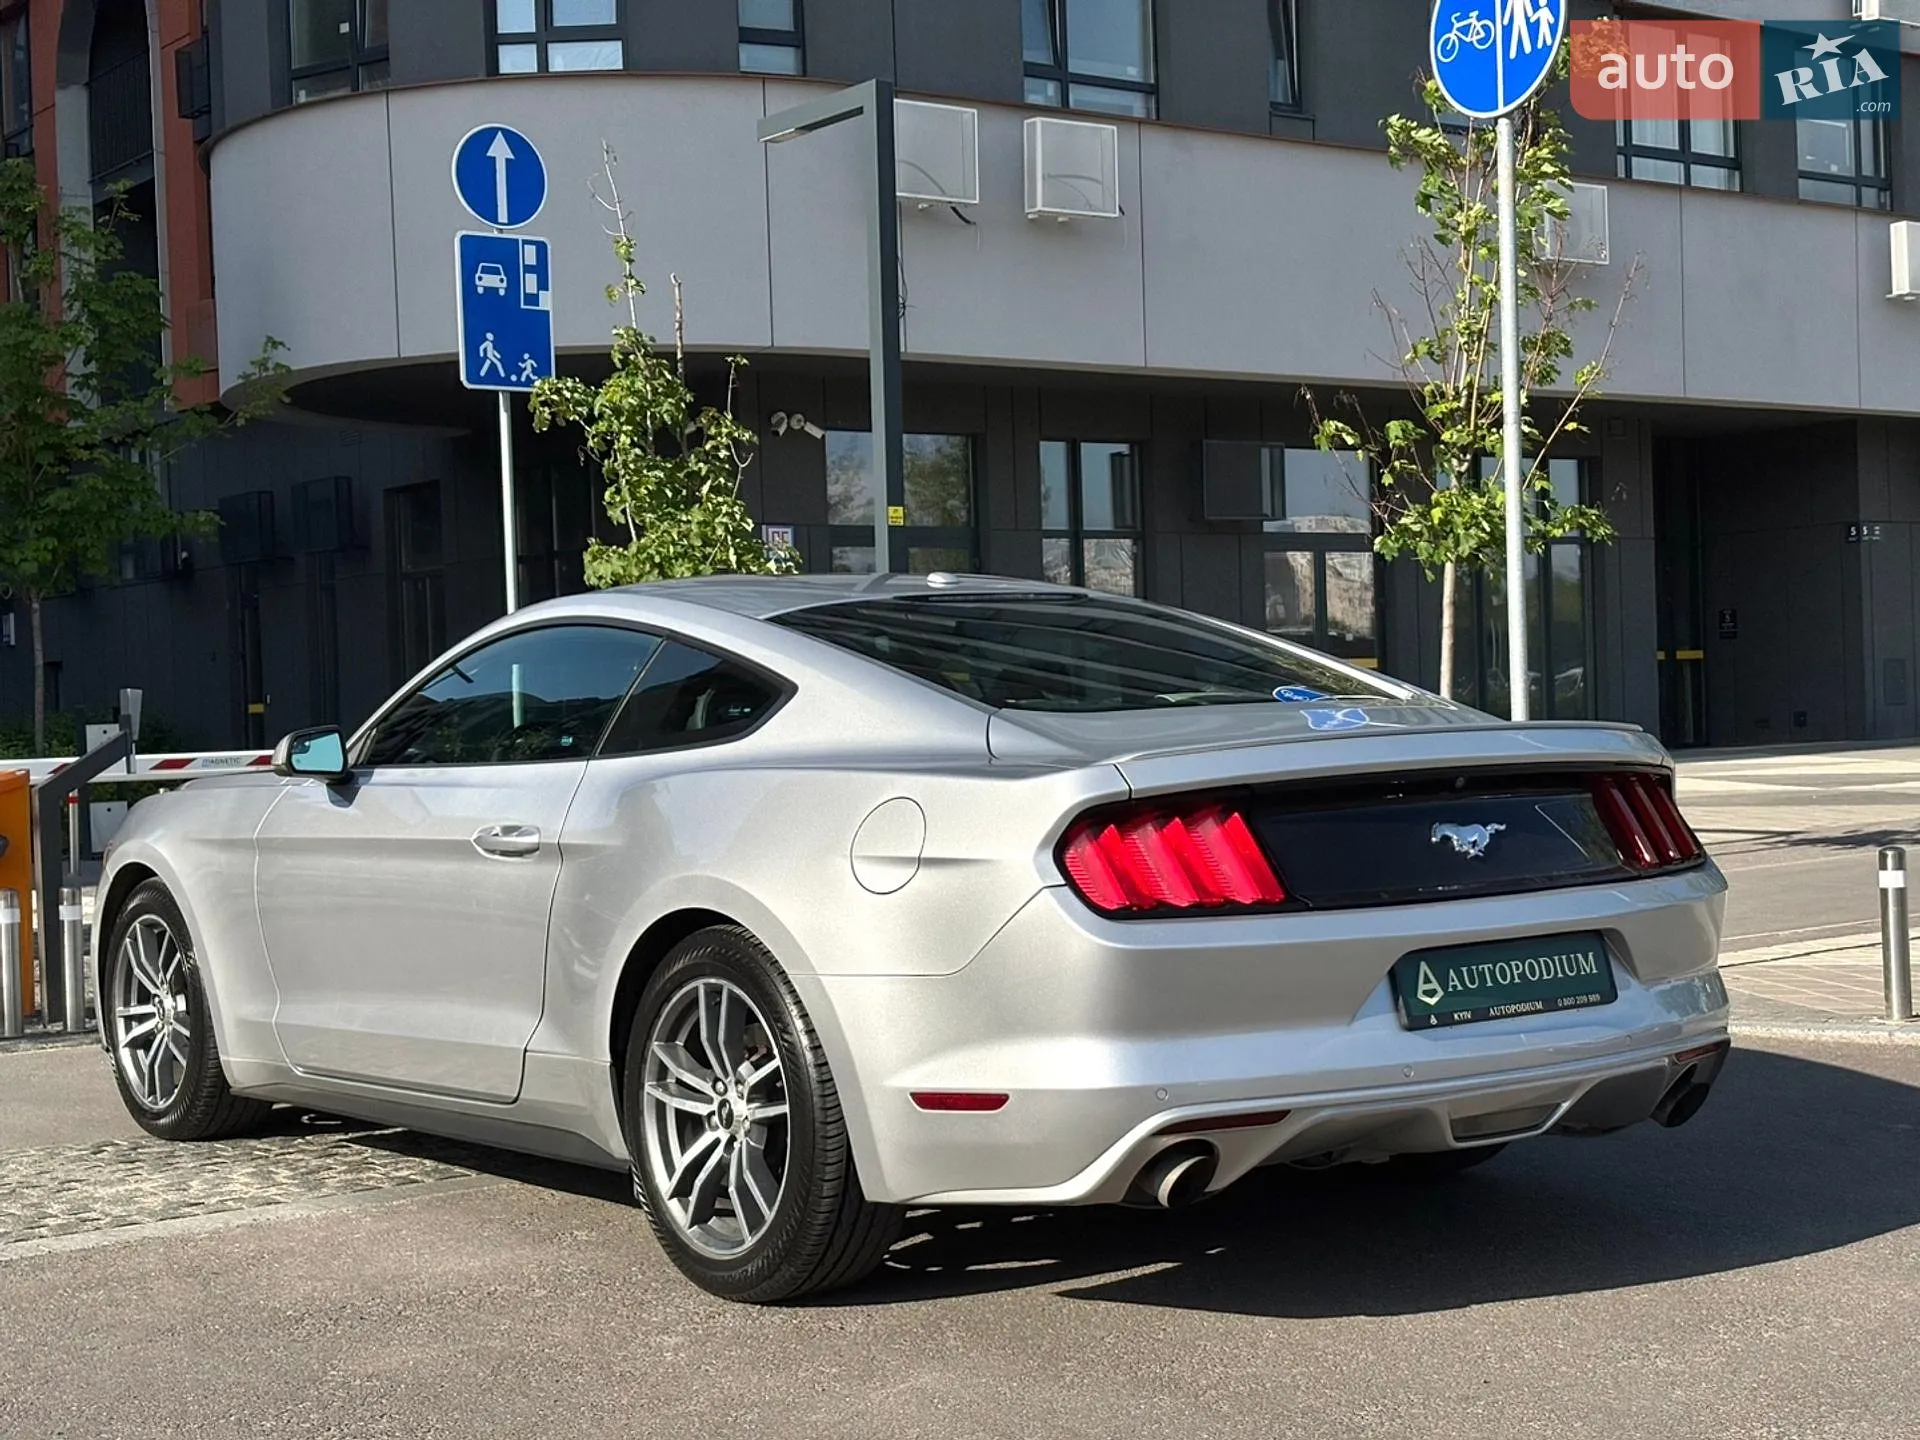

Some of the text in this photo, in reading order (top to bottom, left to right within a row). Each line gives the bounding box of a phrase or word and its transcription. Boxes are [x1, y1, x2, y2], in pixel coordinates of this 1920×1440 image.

[1447, 952, 1598, 992] AUTOPODIUM
[1453, 1010, 1472, 1021] KYIV
[1489, 1000, 1543, 1017] AUTOPODIUM
